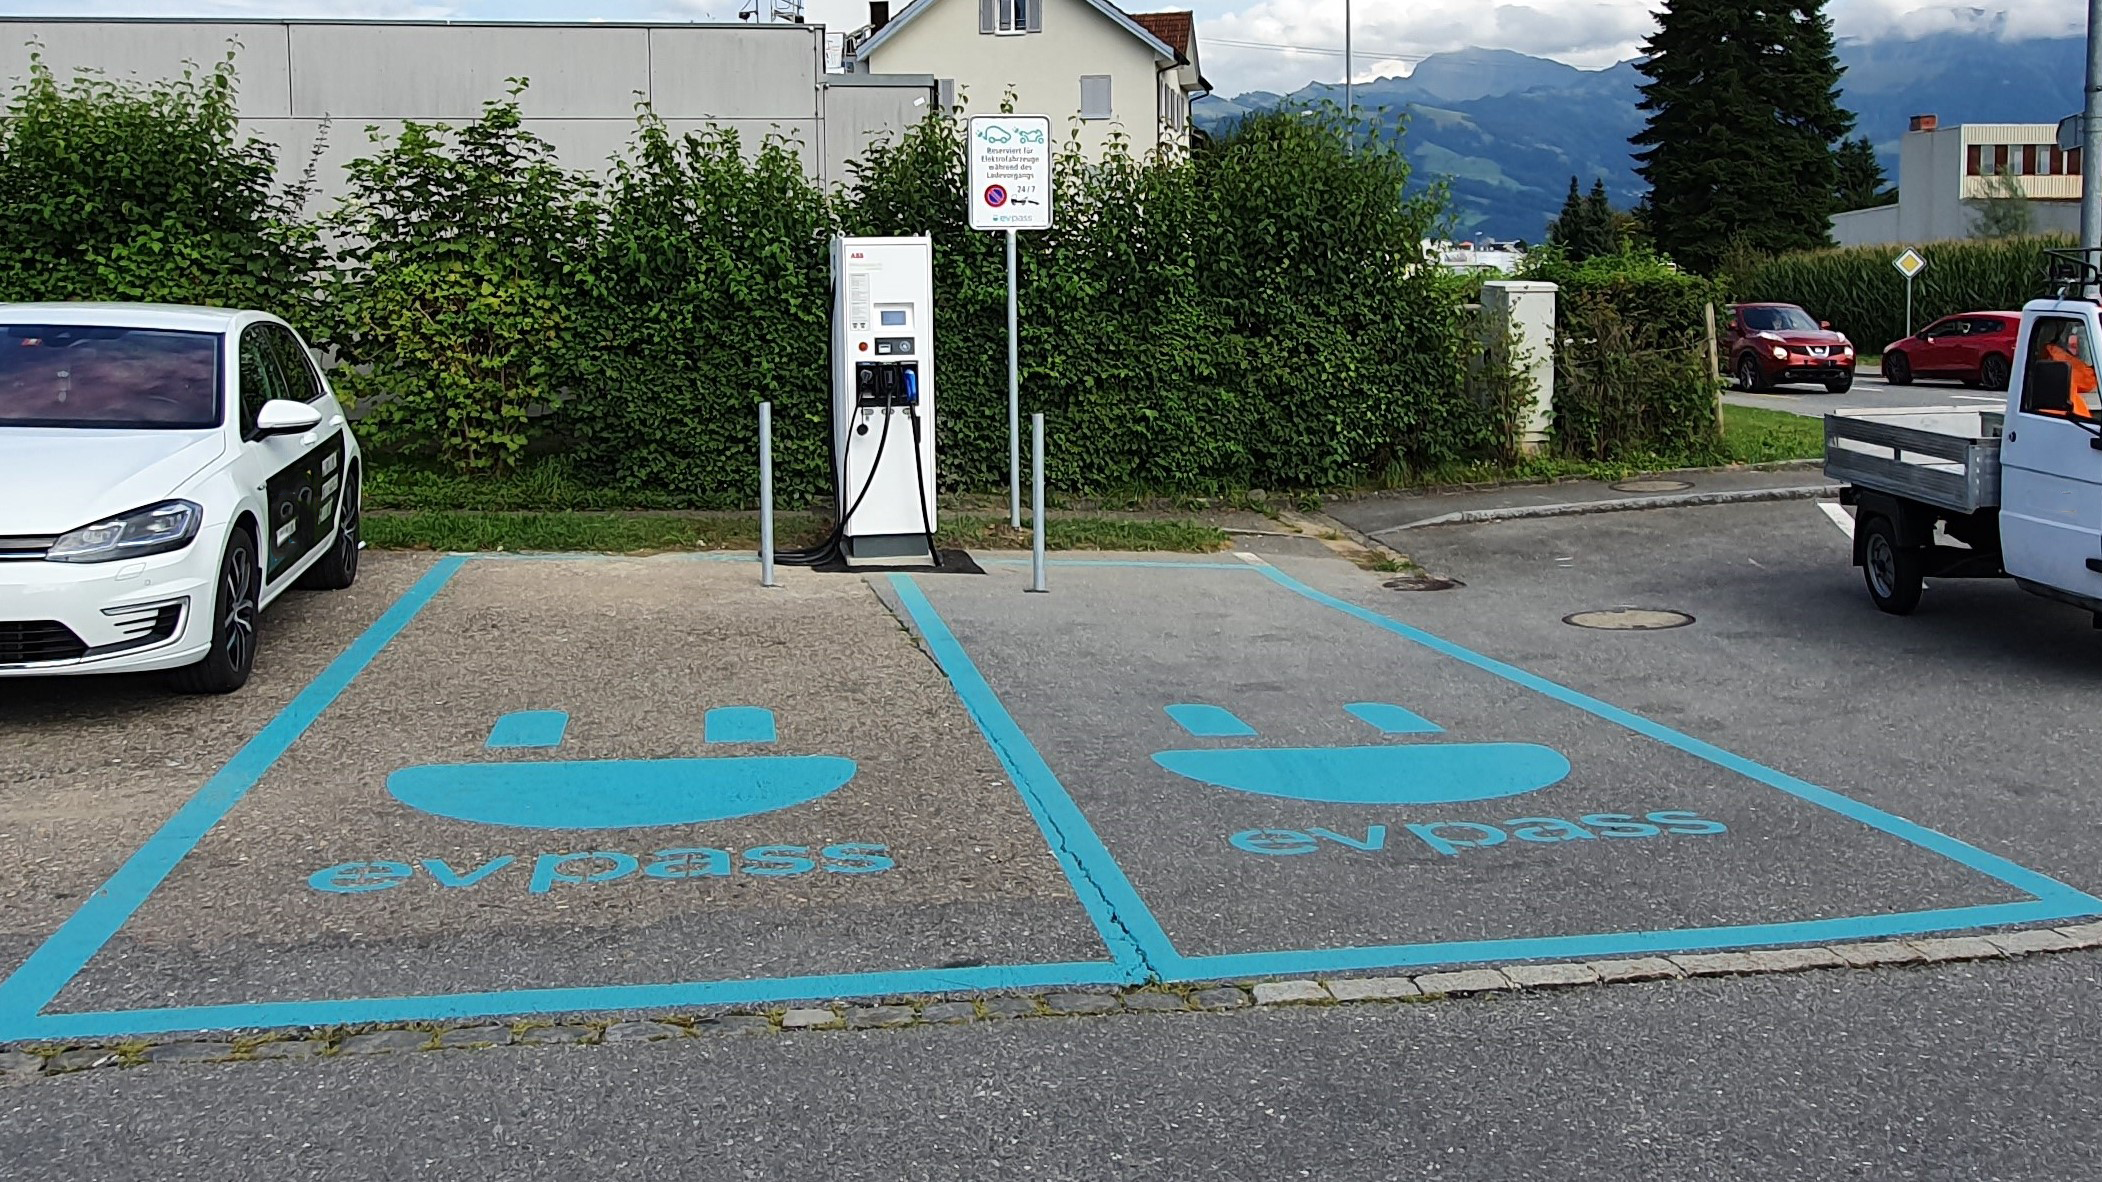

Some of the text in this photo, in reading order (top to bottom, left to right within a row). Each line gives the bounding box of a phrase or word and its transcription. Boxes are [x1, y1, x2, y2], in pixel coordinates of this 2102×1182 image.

[986, 146, 1033, 155] Reserviert für
[981, 155, 1040, 164] Elektrofahrzeuge
[988, 163, 1033, 171] während des
[986, 171, 1035, 180] Ladevorgangs
[1000, 215, 1033, 223] evpass
[1229, 810, 1728, 857] evpass
[307, 842, 895, 895] evpass
